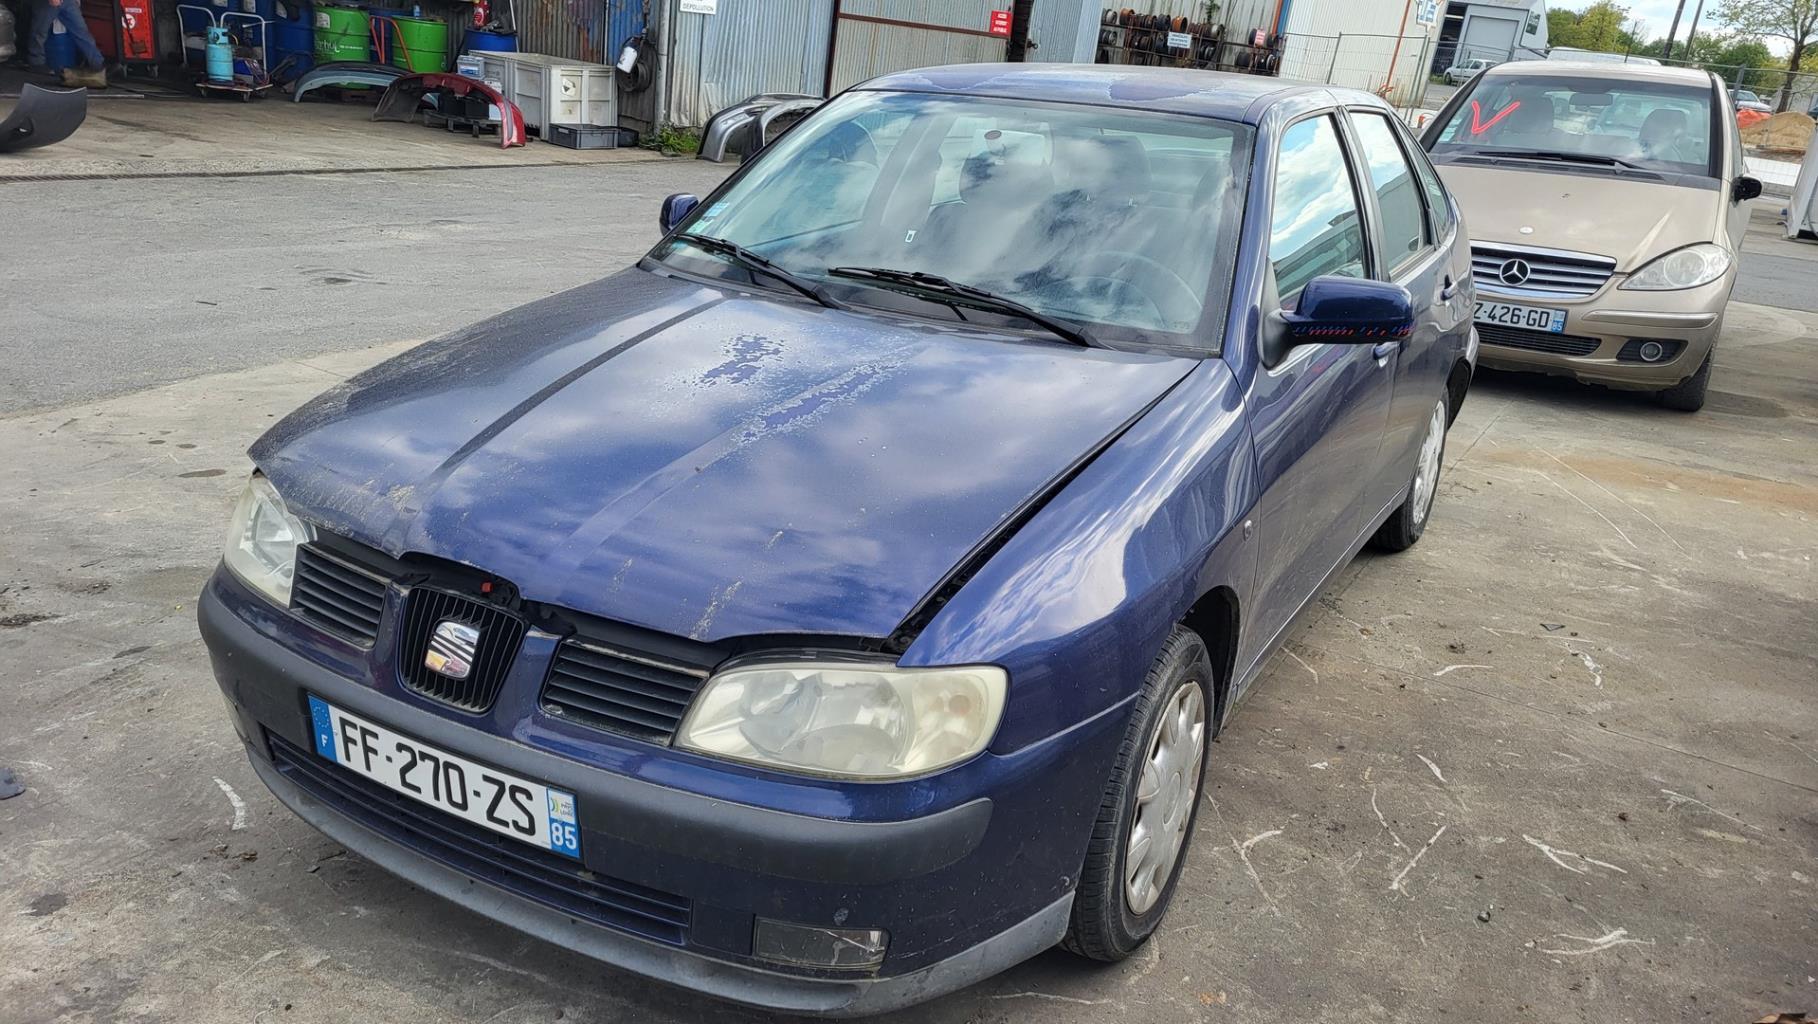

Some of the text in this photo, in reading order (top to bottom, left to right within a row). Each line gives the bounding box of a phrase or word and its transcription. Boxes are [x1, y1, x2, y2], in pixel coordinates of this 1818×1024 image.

[321, 734, 328, 747] F
[339, 716, 536, 836] FF-270-ZS
[551, 822, 577, 850] 85
